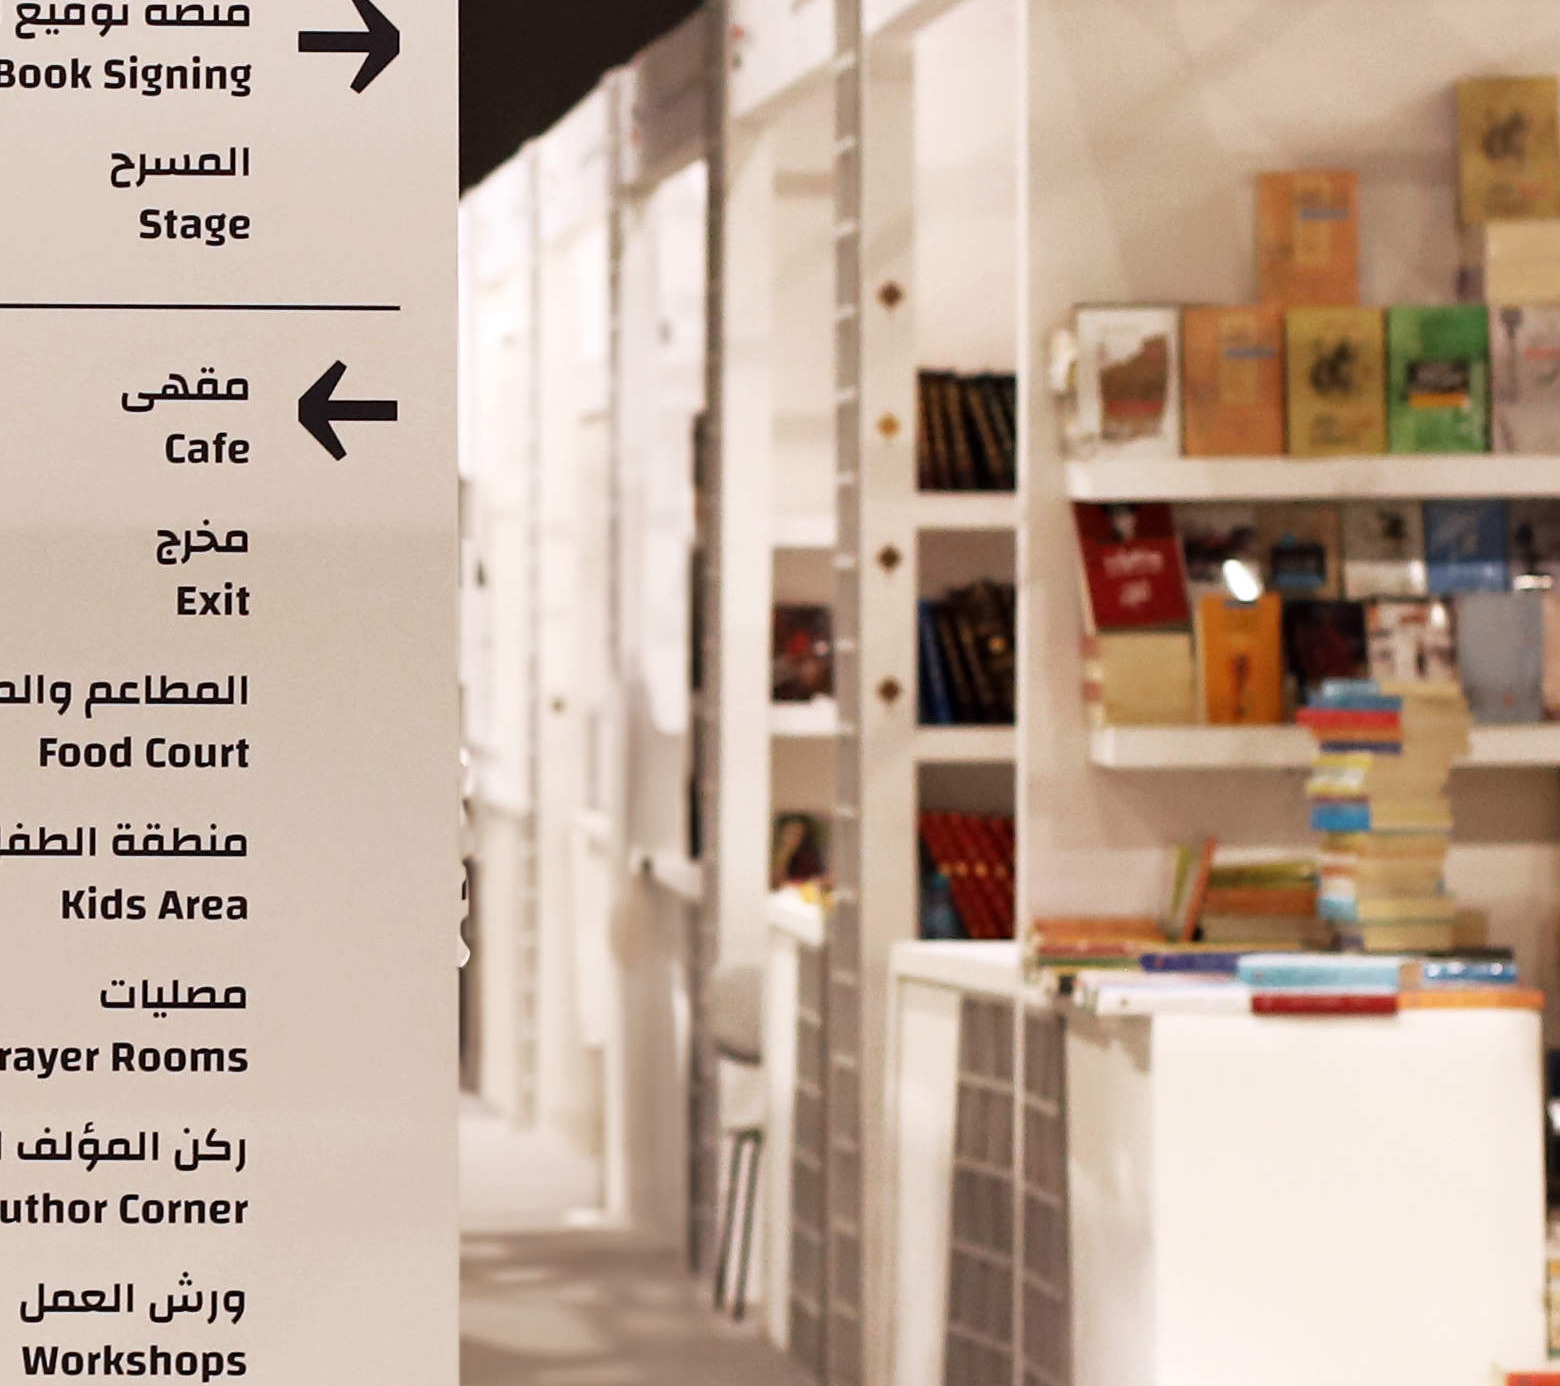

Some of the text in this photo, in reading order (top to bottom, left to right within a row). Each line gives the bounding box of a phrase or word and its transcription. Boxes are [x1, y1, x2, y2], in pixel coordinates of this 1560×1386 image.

[103, 55, 252, 98] Signing
[110, 146, 250, 189] المسرح
[139, 208, 251, 247] Stage
[121, 366, 249, 413] مقهى
[165, 432, 250, 464] Cafe
[156, 518, 249, 566] مخرج
[177, 581, 251, 616] Exit
[84, 674, 248, 719] المطاعم
[39, 736, 250, 768] Food Court
[112, 822, 248, 857] منطقة
[62, 885, 248, 921] Kids Area
[100, 979, 247, 1019] مصليات
[111, 1042, 248, 1073] Rooms
[17, 1121, 159, 1173] المؤلف
[174, 1127, 246, 1173] ركن
[119, 1193, 249, 1225] Corner
[19, 1271, 245, 1325] ورش العمل
[21, 1344, 247, 1384] Workshops
